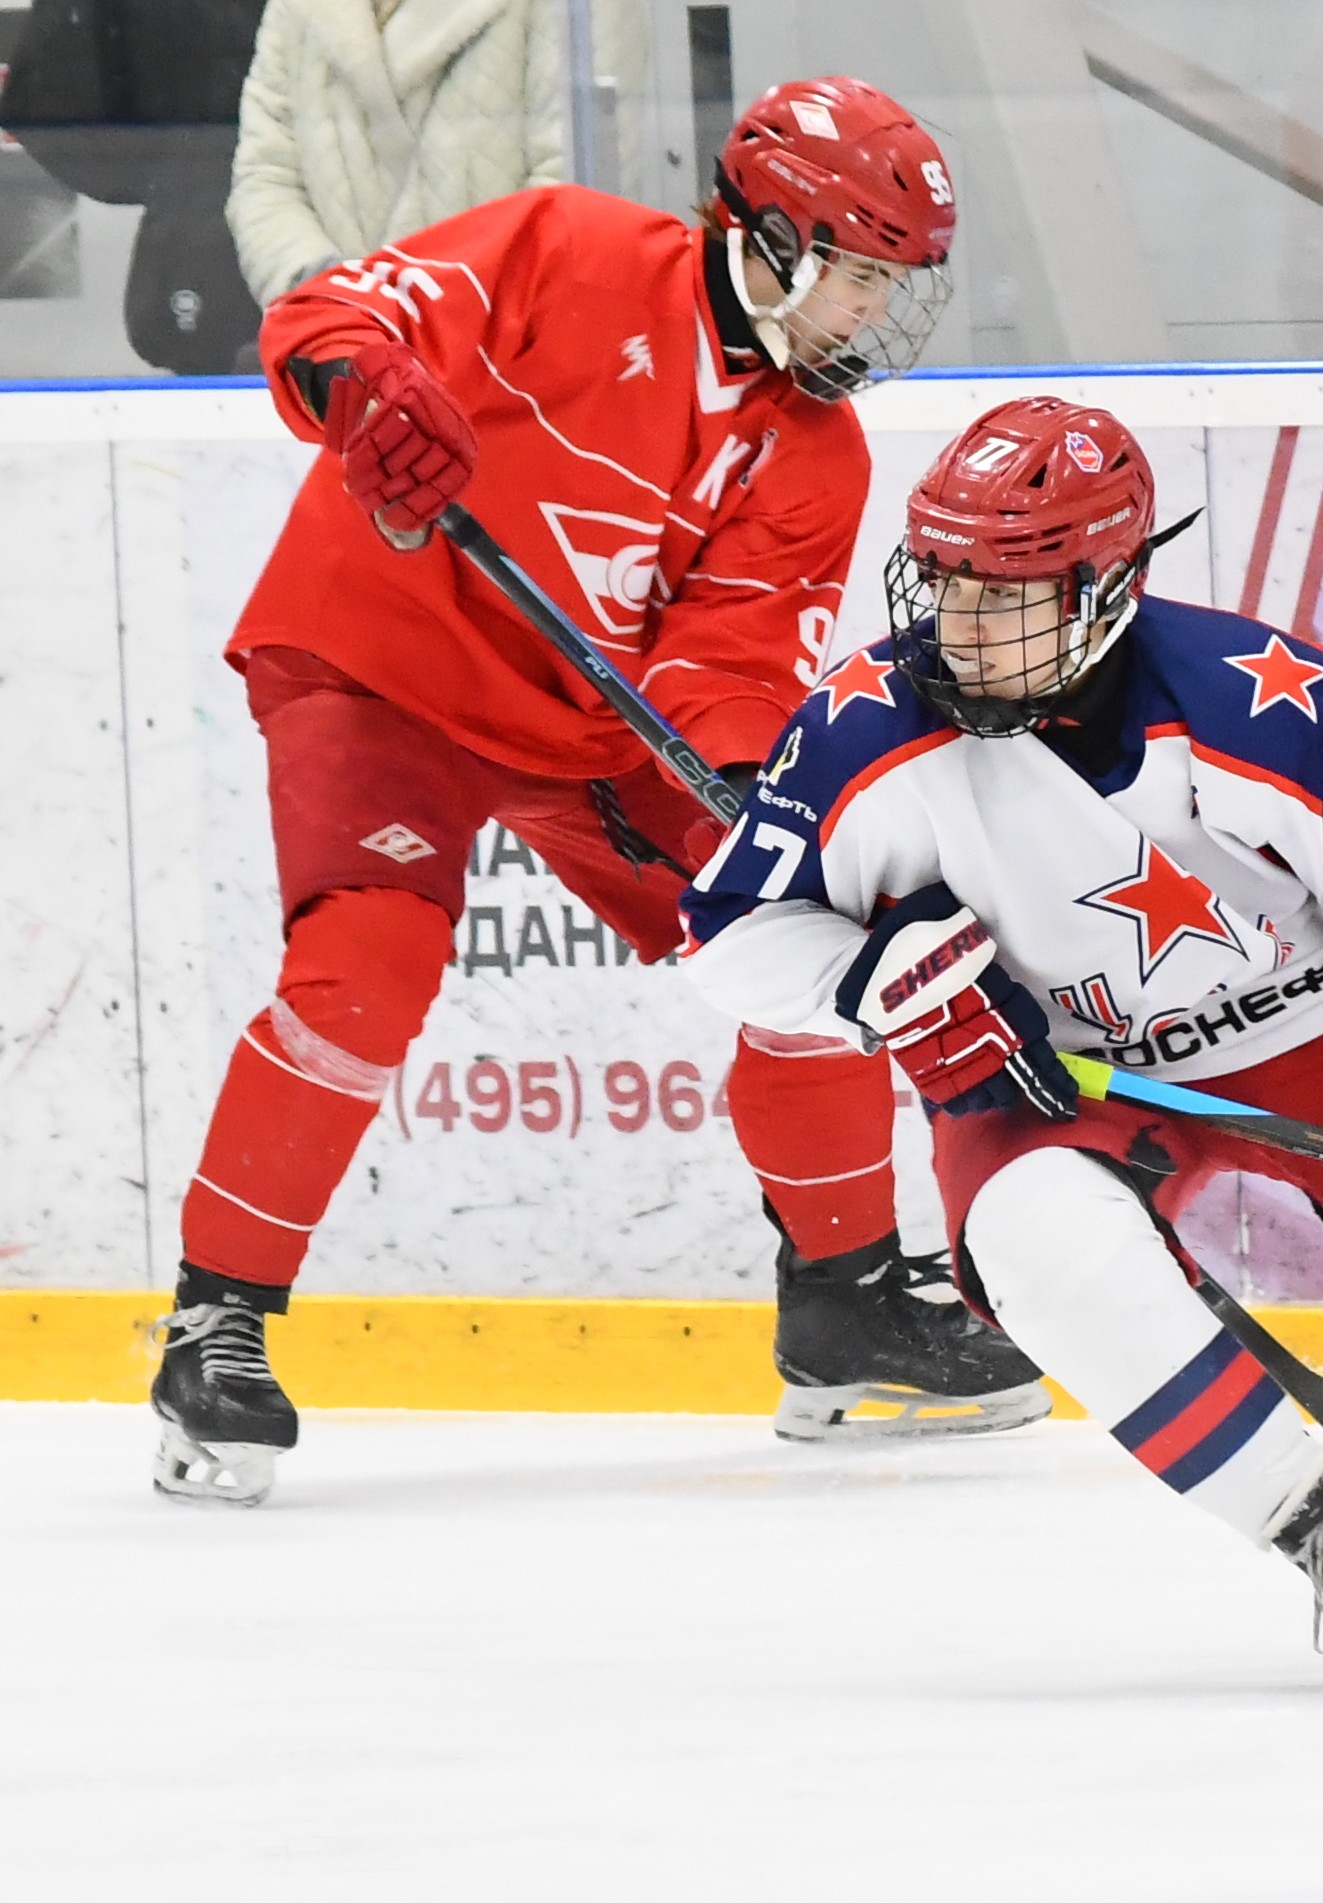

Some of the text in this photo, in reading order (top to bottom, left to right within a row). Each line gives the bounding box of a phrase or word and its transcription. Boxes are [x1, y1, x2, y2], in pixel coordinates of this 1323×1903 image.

[661, 736, 744, 826] CC
[394, 1055, 732, 1140] (495) 96
